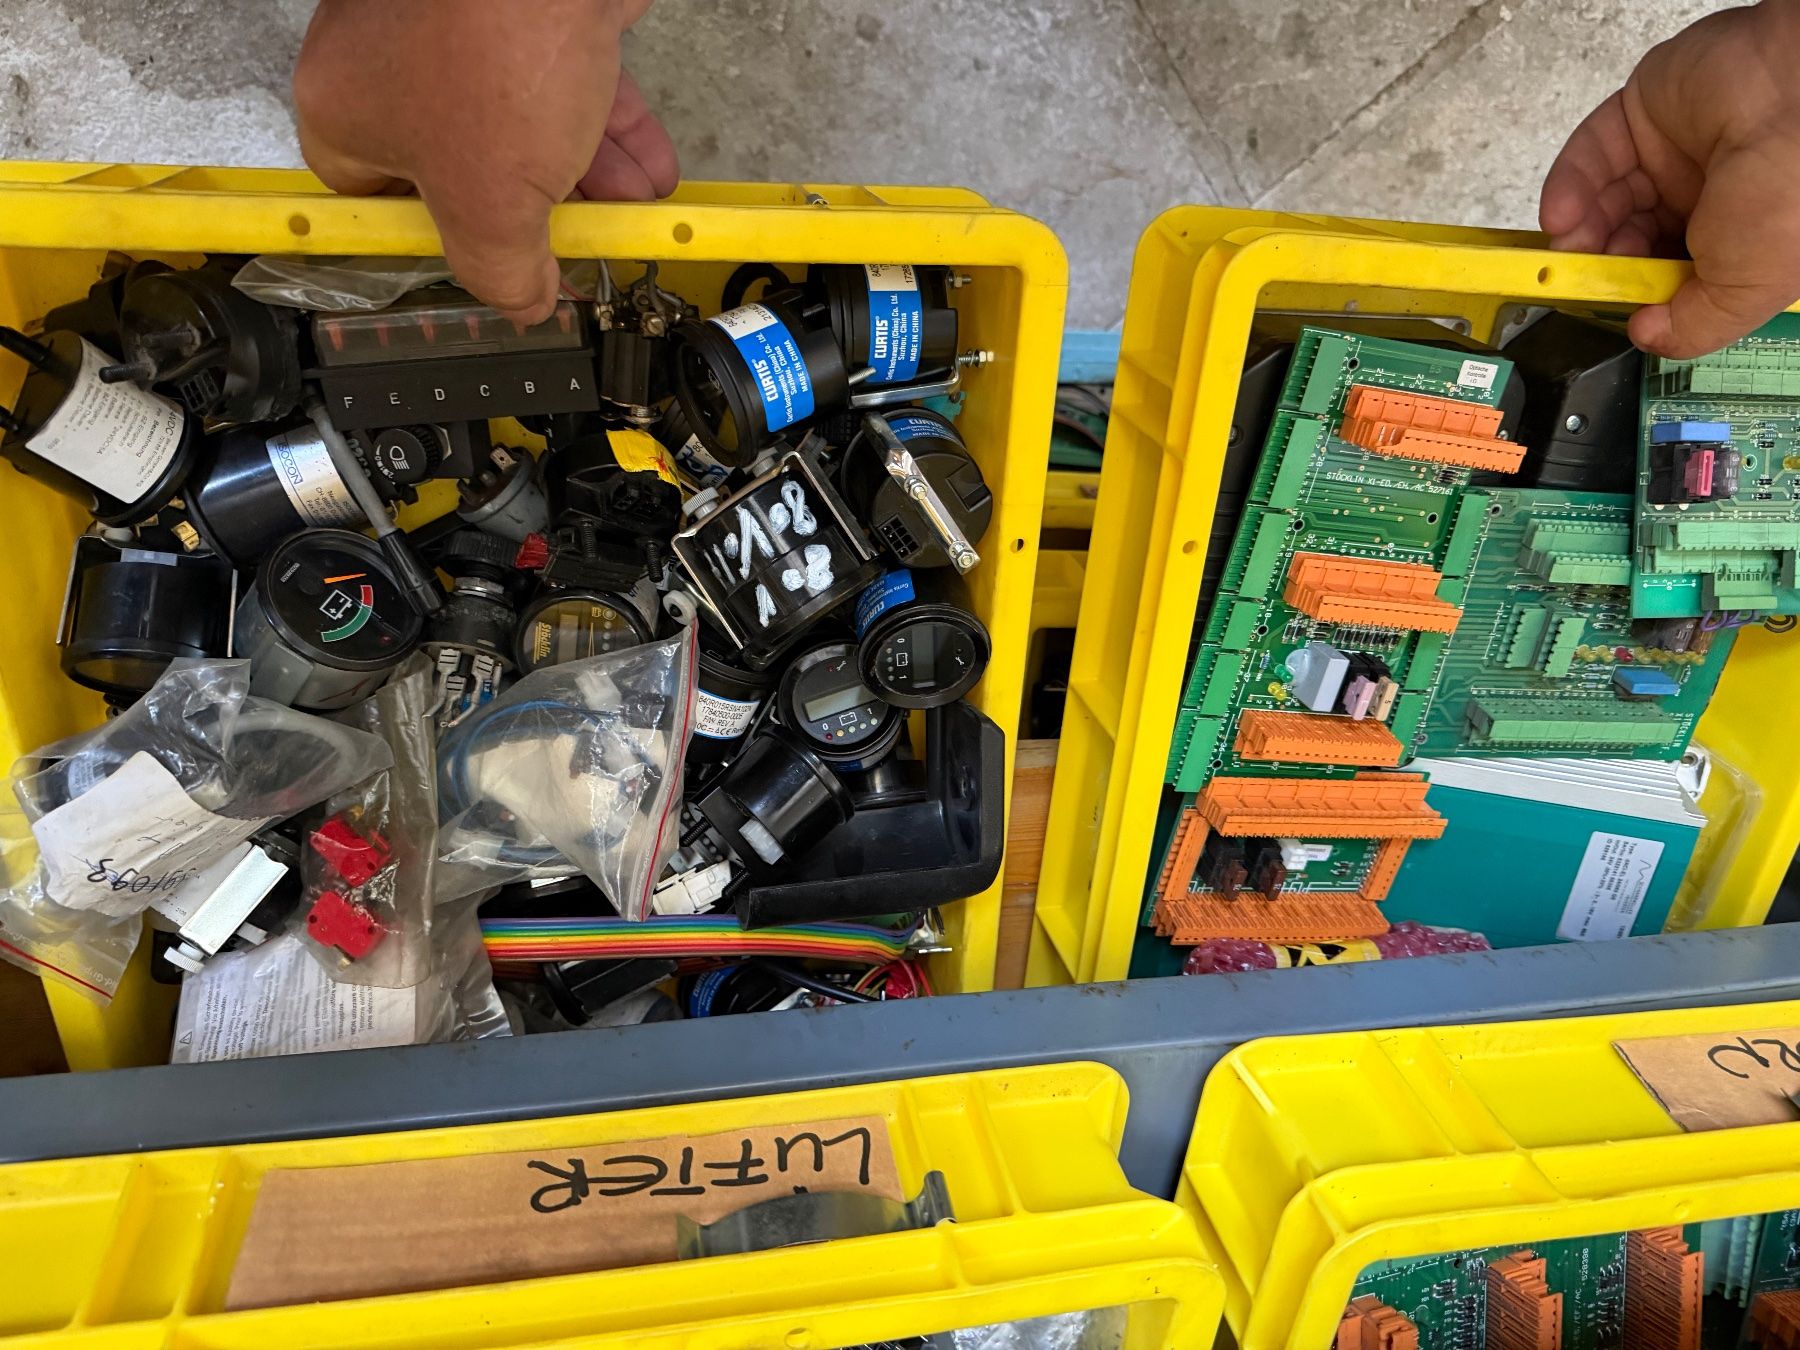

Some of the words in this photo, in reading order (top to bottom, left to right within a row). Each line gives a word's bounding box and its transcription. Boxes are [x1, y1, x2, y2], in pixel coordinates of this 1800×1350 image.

[890, 293, 898, 304] Ltd.
[892, 317, 900, 338] (China)
[899, 312, 907, 333] China
[911, 310, 919, 332] CHINA
[755, 332, 766, 343] Ltd.
[897, 335, 908, 360] Suzhou,
[911, 334, 918, 342] IN
[762, 343, 772, 354] Co.
[774, 344, 787, 366] China
[782, 338, 798, 362] CHINA
[888, 339, 899, 368] Instruments
[909, 343, 918, 361] MADE
[766, 352, 783, 375] (China)
[793, 361, 802, 371] IN
[885, 368, 894, 380] Curtis
[777, 373, 792, 407] Instruments
[783, 366, 797, 395] Suzhou,
[796, 371, 808, 392] MADE
[343, 396, 353, 409] F
[389, 391, 400, 405] E
[434, 387, 445, 401] D
[479, 383, 490, 397] C
[524, 380, 535, 394] B
[569, 377, 580, 390] A
[1325, 468, 1365, 483] STÖCKLIN
[528, 1126, 872, 1214] LÜFTER
